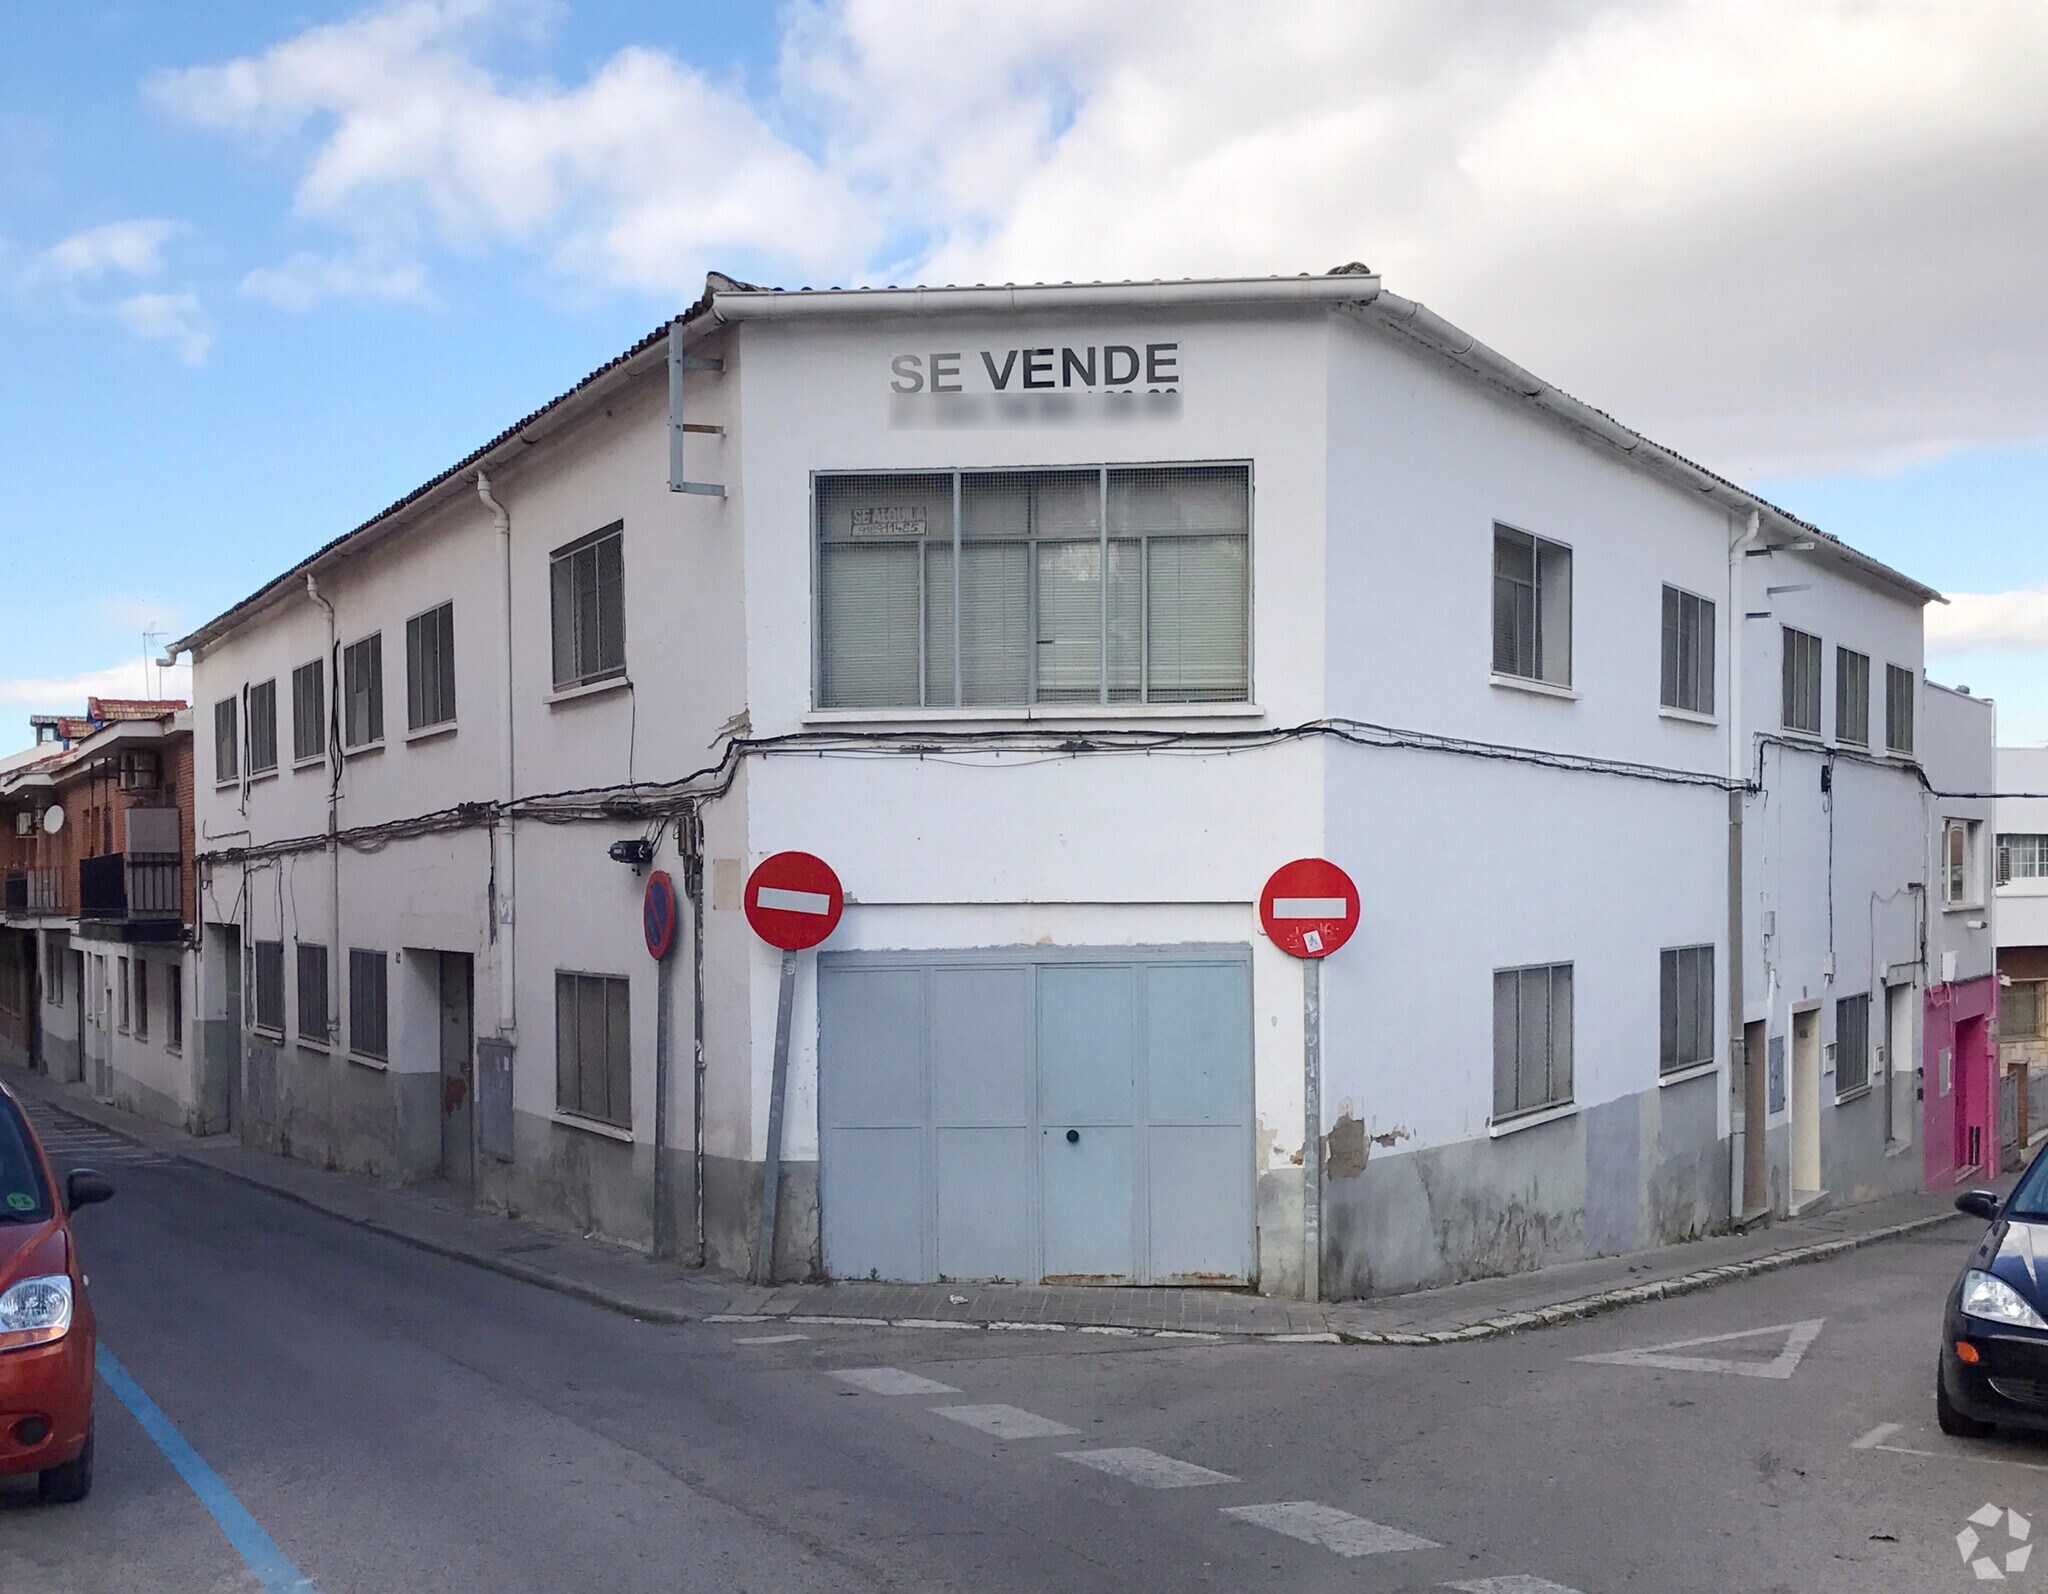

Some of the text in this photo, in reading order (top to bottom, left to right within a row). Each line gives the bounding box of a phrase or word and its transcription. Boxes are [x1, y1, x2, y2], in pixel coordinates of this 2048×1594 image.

[890, 343, 1179, 393] SE VENDE
[853, 507, 926, 524] SE ALQUILA
